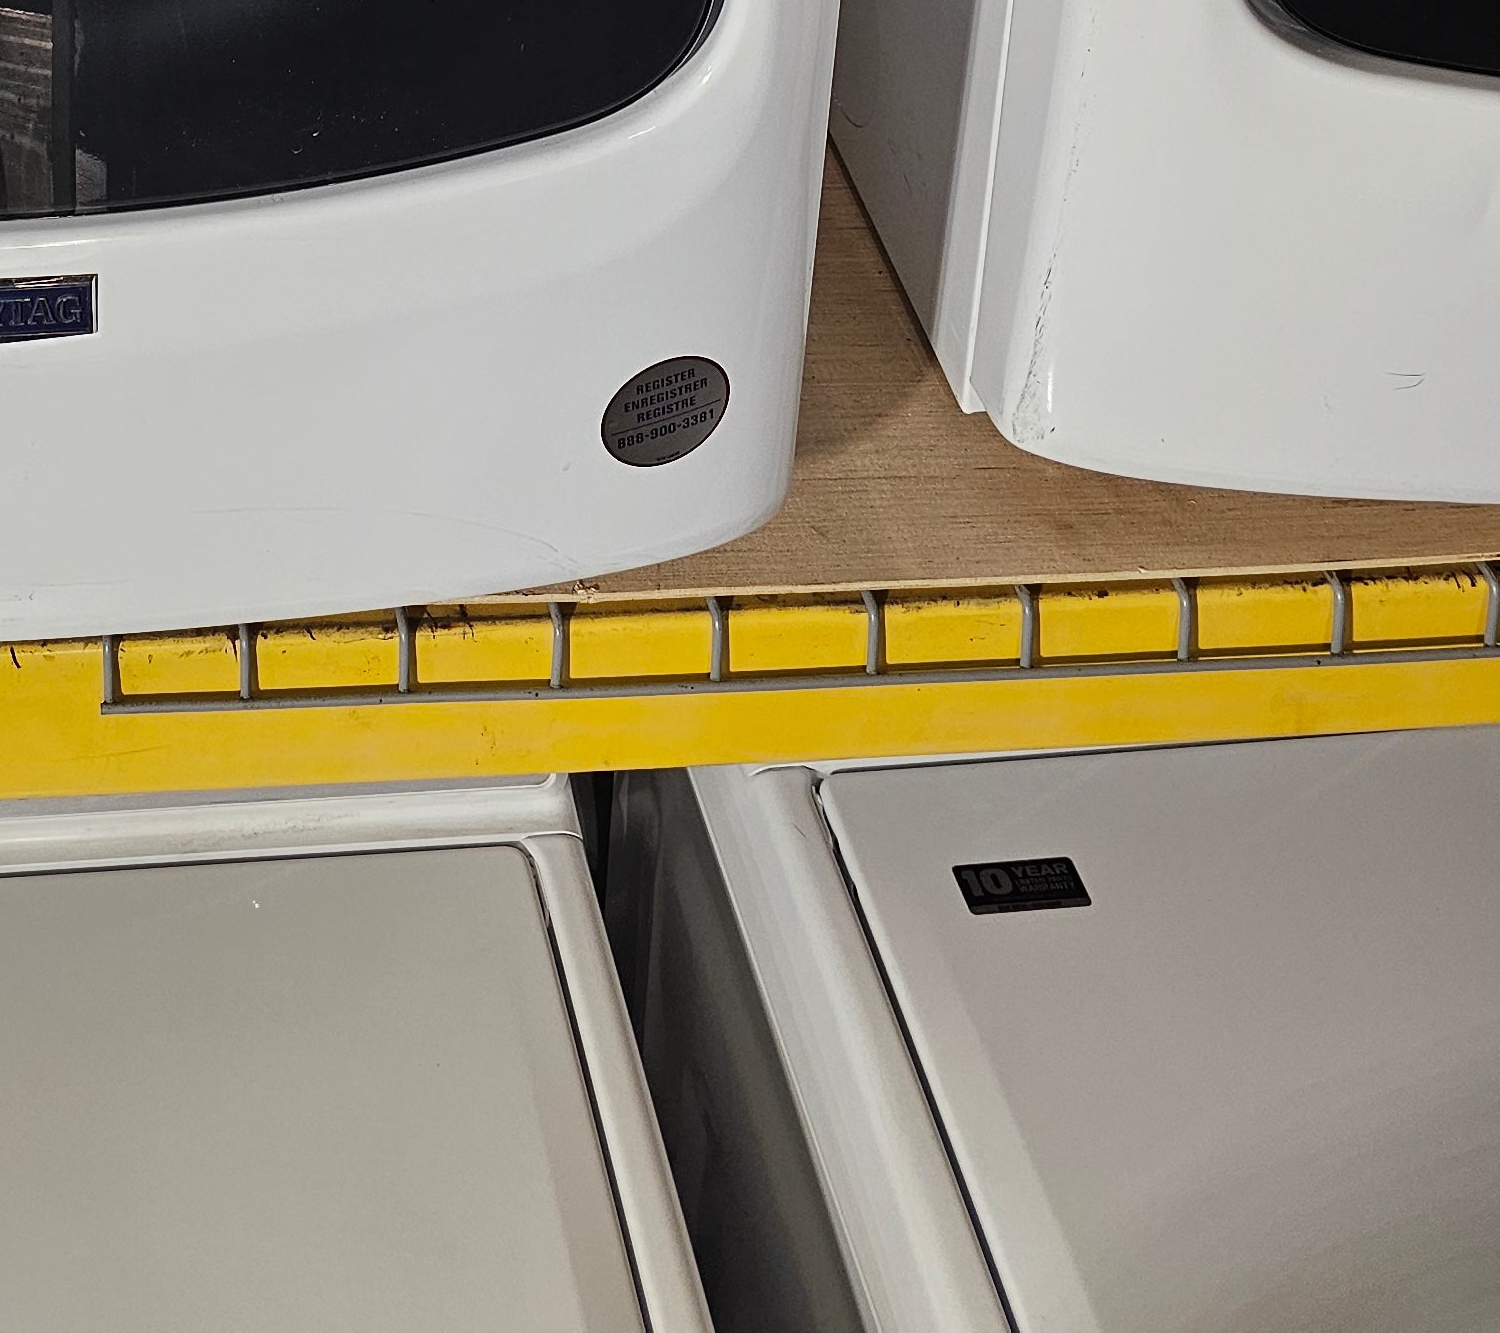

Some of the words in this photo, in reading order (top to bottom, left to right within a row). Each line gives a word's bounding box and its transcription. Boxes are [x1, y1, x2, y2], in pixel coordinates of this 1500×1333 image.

[623, 377, 708, 413] ENREGISTRER
[636, 368, 696, 395] REGISTER
[637, 395, 697, 424] REGISTRE
[617, 408, 715, 450] 888-900-3381
[961, 868, 1013, 897] 10
[1010, 862, 1069, 877] YEAR
